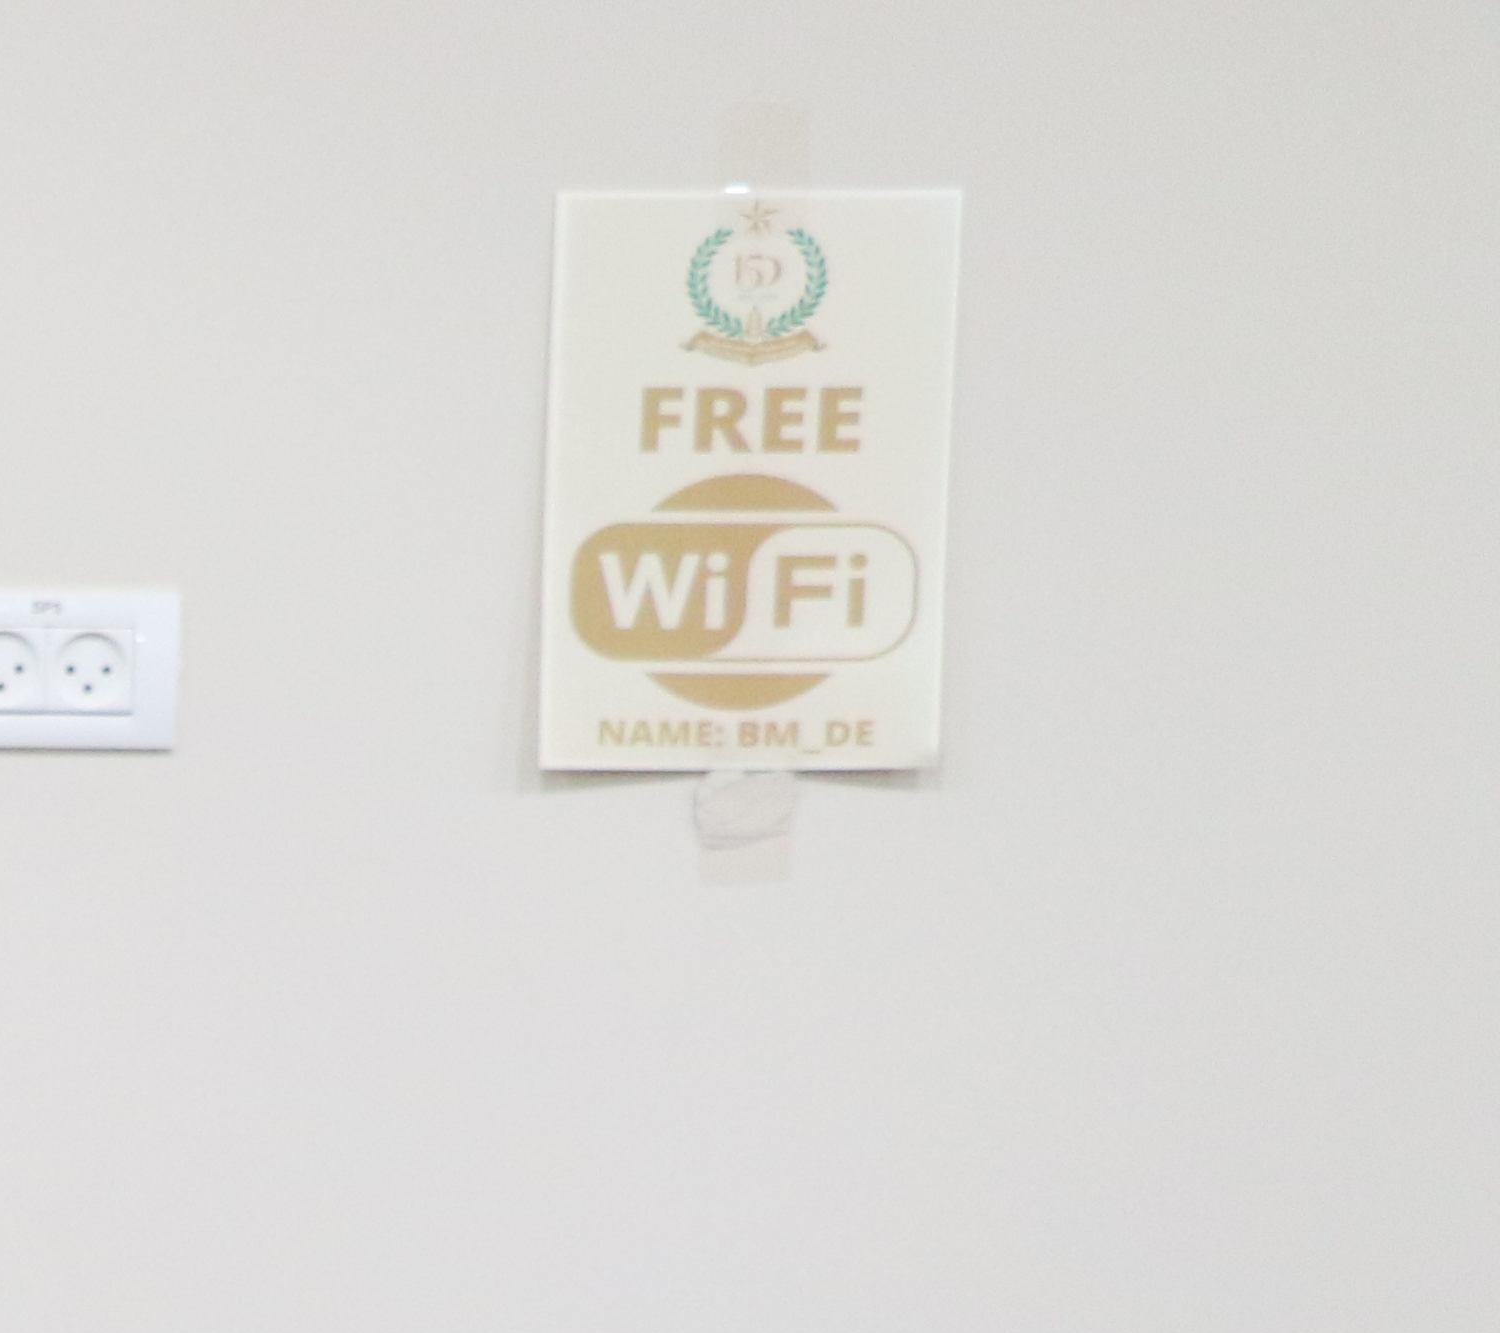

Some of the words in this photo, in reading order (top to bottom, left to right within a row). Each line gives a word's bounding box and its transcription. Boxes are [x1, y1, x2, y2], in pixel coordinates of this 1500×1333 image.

[639, 386, 863, 453] FREE
[597, 719, 724, 748] NAME:
[736, 719, 877, 754] BM_DE
